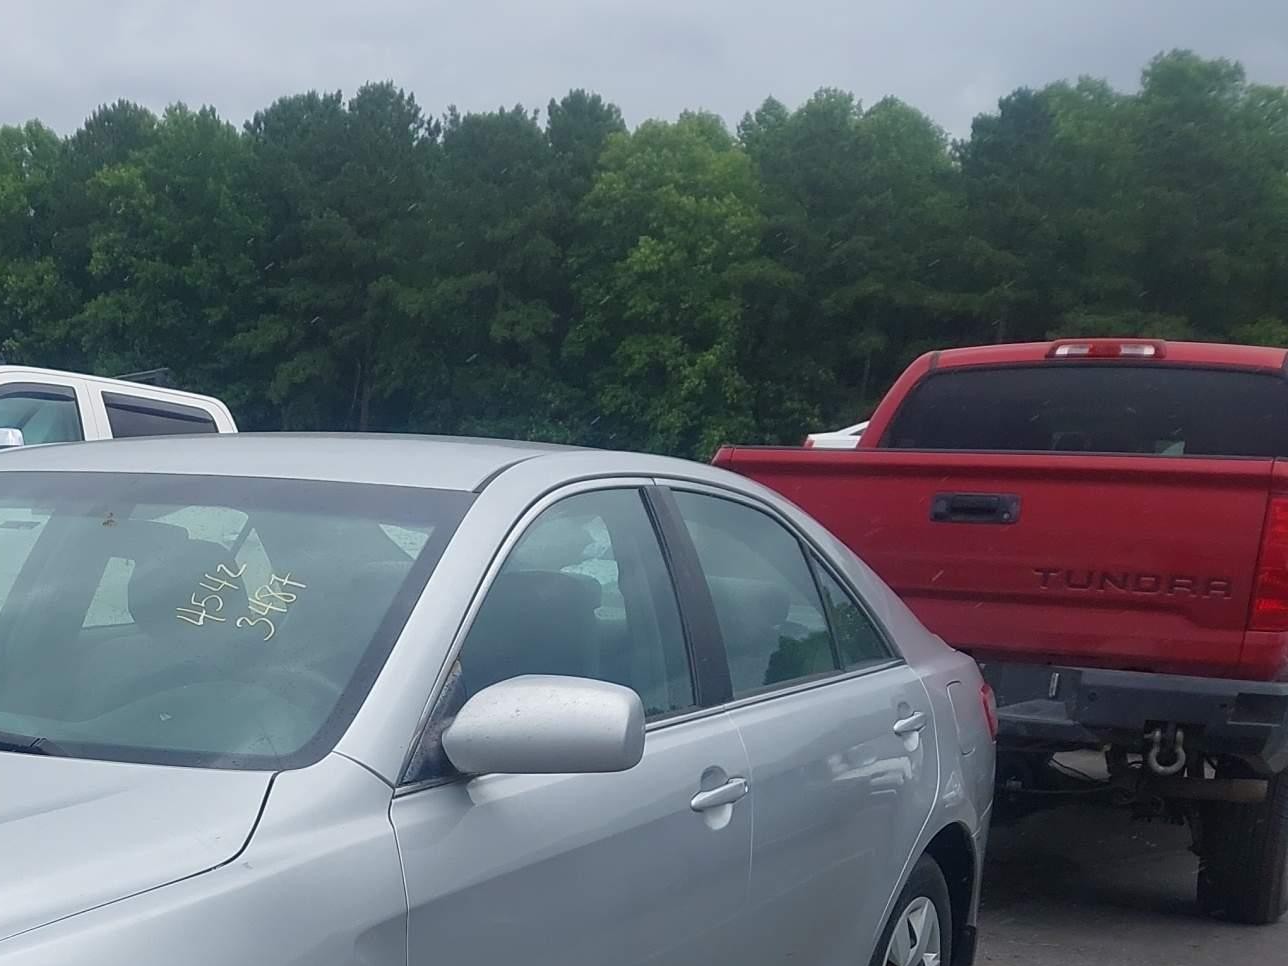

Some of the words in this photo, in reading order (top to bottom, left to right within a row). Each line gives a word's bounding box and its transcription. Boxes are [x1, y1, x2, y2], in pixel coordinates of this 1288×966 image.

[175, 563, 248, 626] 4542
[236, 572, 308, 641] 3487
[1031, 567, 1233, 600] TUNDRA
